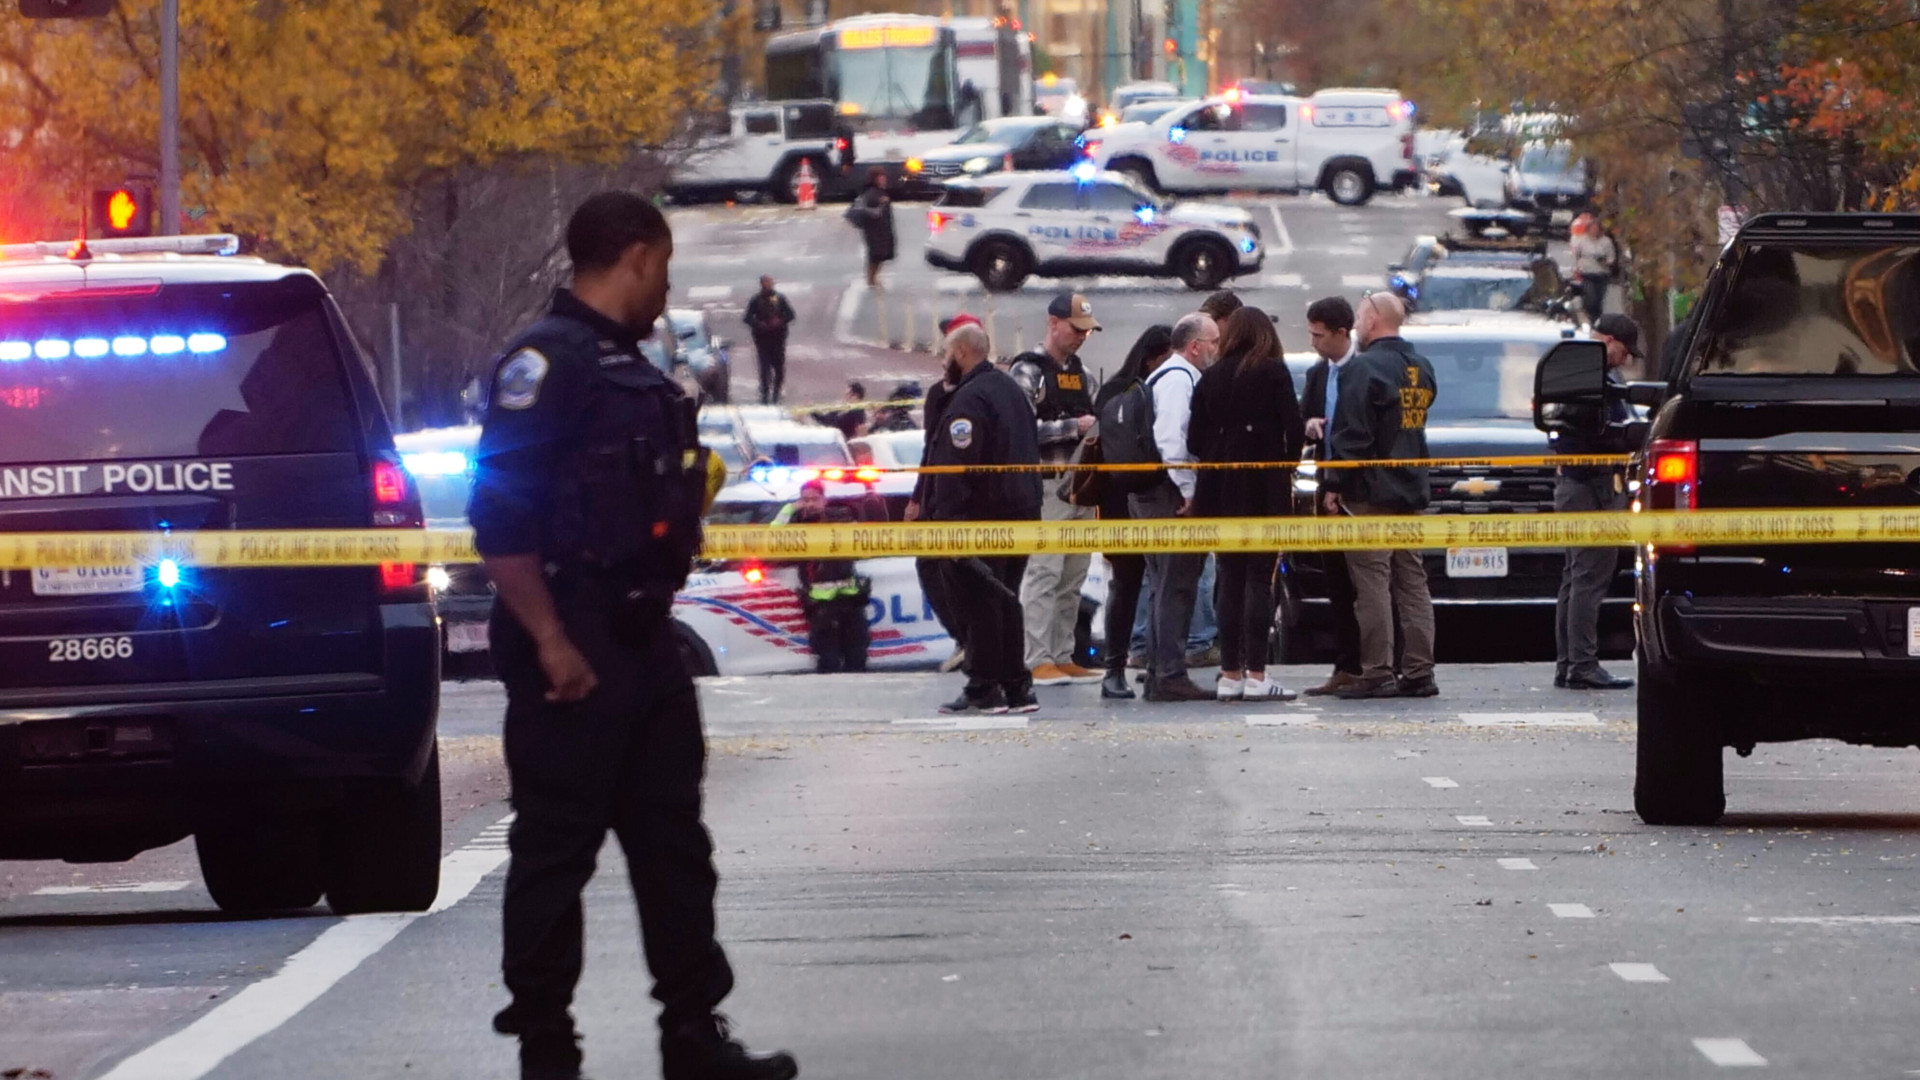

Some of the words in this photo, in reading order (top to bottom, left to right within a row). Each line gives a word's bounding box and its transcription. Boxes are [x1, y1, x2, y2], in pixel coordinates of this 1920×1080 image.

[1200, 150, 1279, 162] POLICE
[0, 465, 88, 497] NSIT
[103, 462, 234, 493] POLICE
[1059, 527, 1099, 548] POLICE
[1103, 526, 1129, 548] LINE
[1132, 526, 1148, 547] DO
[1153, 526, 1177, 547] NOT
[1180, 525, 1220, 547] CROSS
[1262, 524, 1303, 545] POLICE
[1307, 523, 1332, 545] LINE
[1336, 523, 1353, 544] DO
[1357, 523, 1381, 544] NOT
[1384, 522, 1424, 544] CROSS
[1468, 521, 1511, 542] POLICE
[1514, 520, 1539, 541] LINE
[1589, 519, 1631, 540] CROSS
[1749, 517, 1765, 537] DO
[1768, 517, 1791, 537] NOT
[1796, 516, 1834, 537] CROSS
[239, 537, 280, 560] POLICE
[768, 529, 808, 552] CROSS
[852, 529, 894, 551] POLICE
[899, 528, 923, 550] LINE
[926, 528, 943, 550] DO
[947, 528, 971, 550] NOT
[975, 527, 1015, 549] CROSS
[48, 636, 134, 662] 28666
